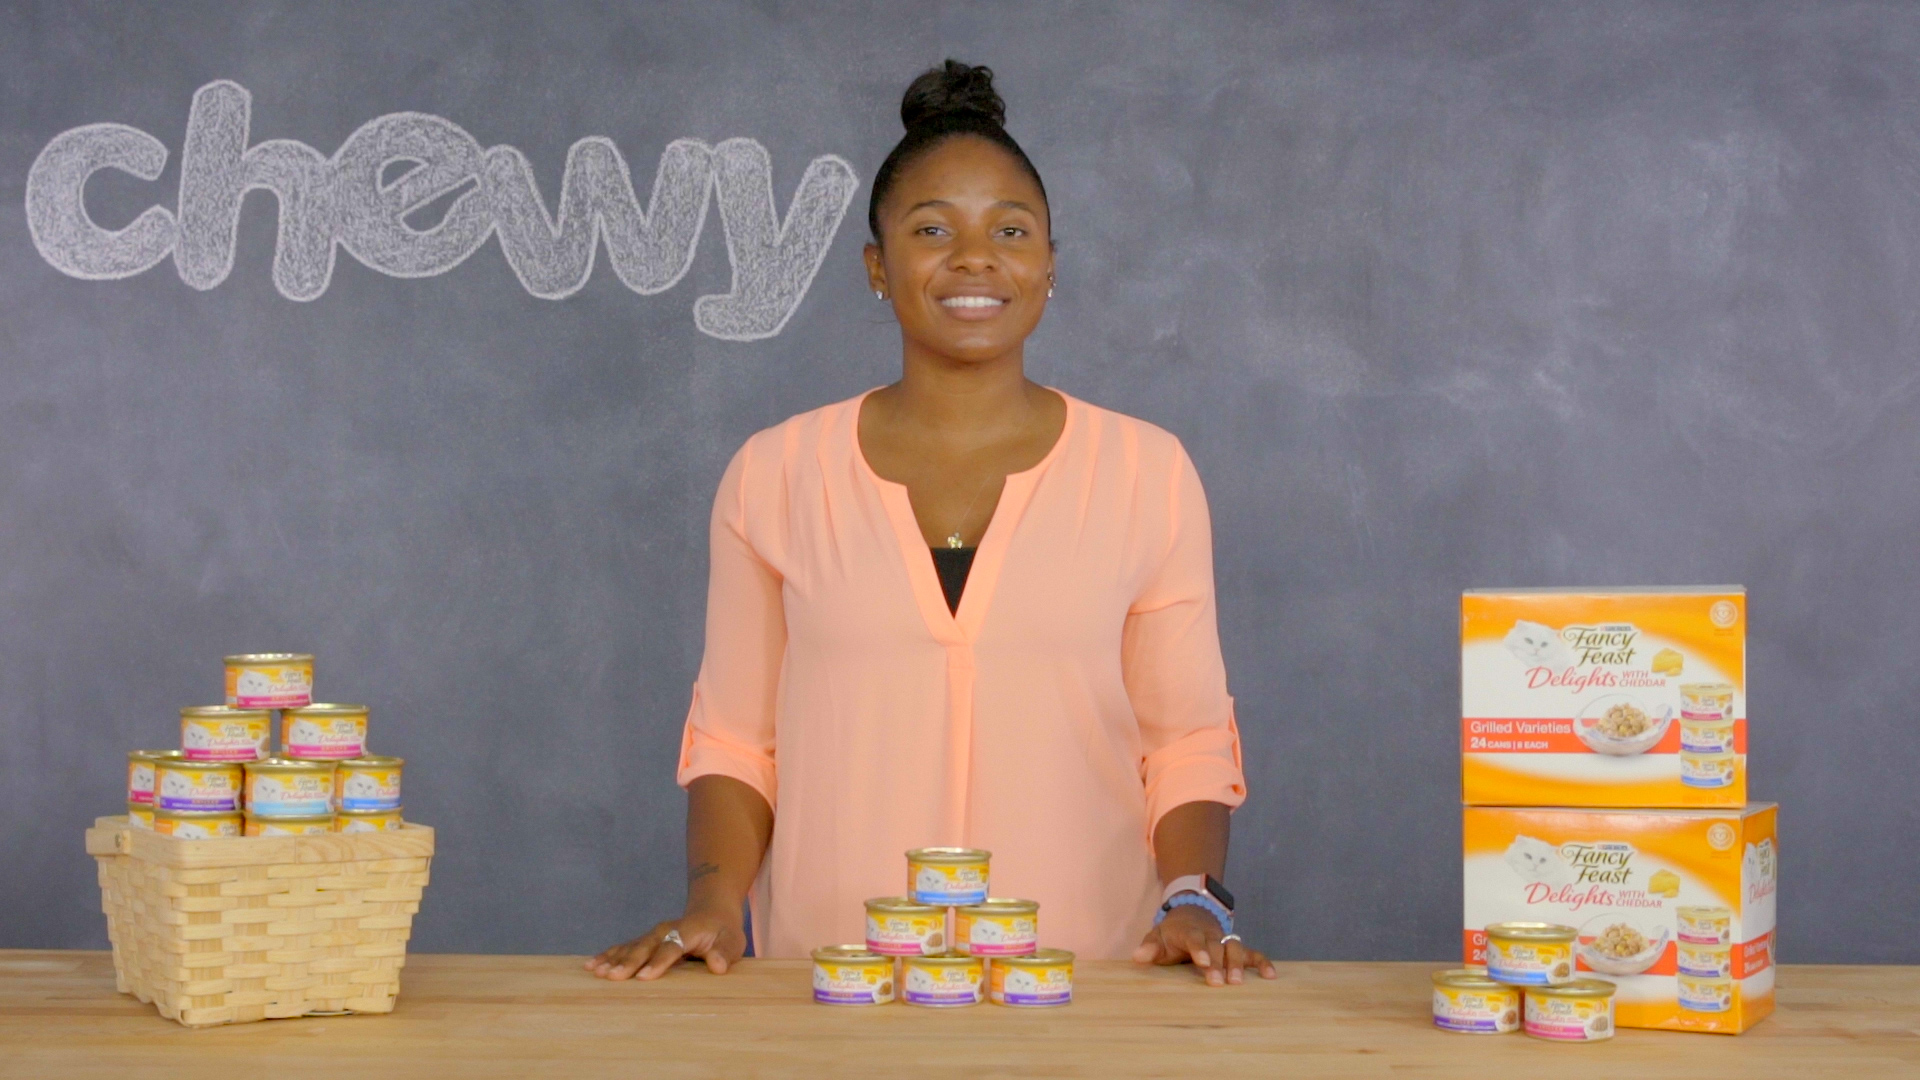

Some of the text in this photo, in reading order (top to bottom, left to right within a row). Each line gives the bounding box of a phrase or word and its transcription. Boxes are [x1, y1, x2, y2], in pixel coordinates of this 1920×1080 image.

[26, 79, 860, 341] chewy
[1563, 627, 1638, 651] Fancy
[1577, 645, 1638, 667] Feast
[1525, 665, 1618, 694] Delights
[1619, 678, 1666, 688] CHEDDAR
[1622, 669, 1649, 678] WITH
[1470, 721, 1571, 734] Grilled Varieties
[1470, 737, 1487, 748] 24
[1524, 741, 1549, 749] EACH
[1561, 844, 1635, 870] Fancy
[1573, 863, 1633, 885] Feast
[1525, 882, 1615, 912] Delights
[1616, 898, 1663, 908] CHEDDAR
[1619, 890, 1645, 898] WITH
